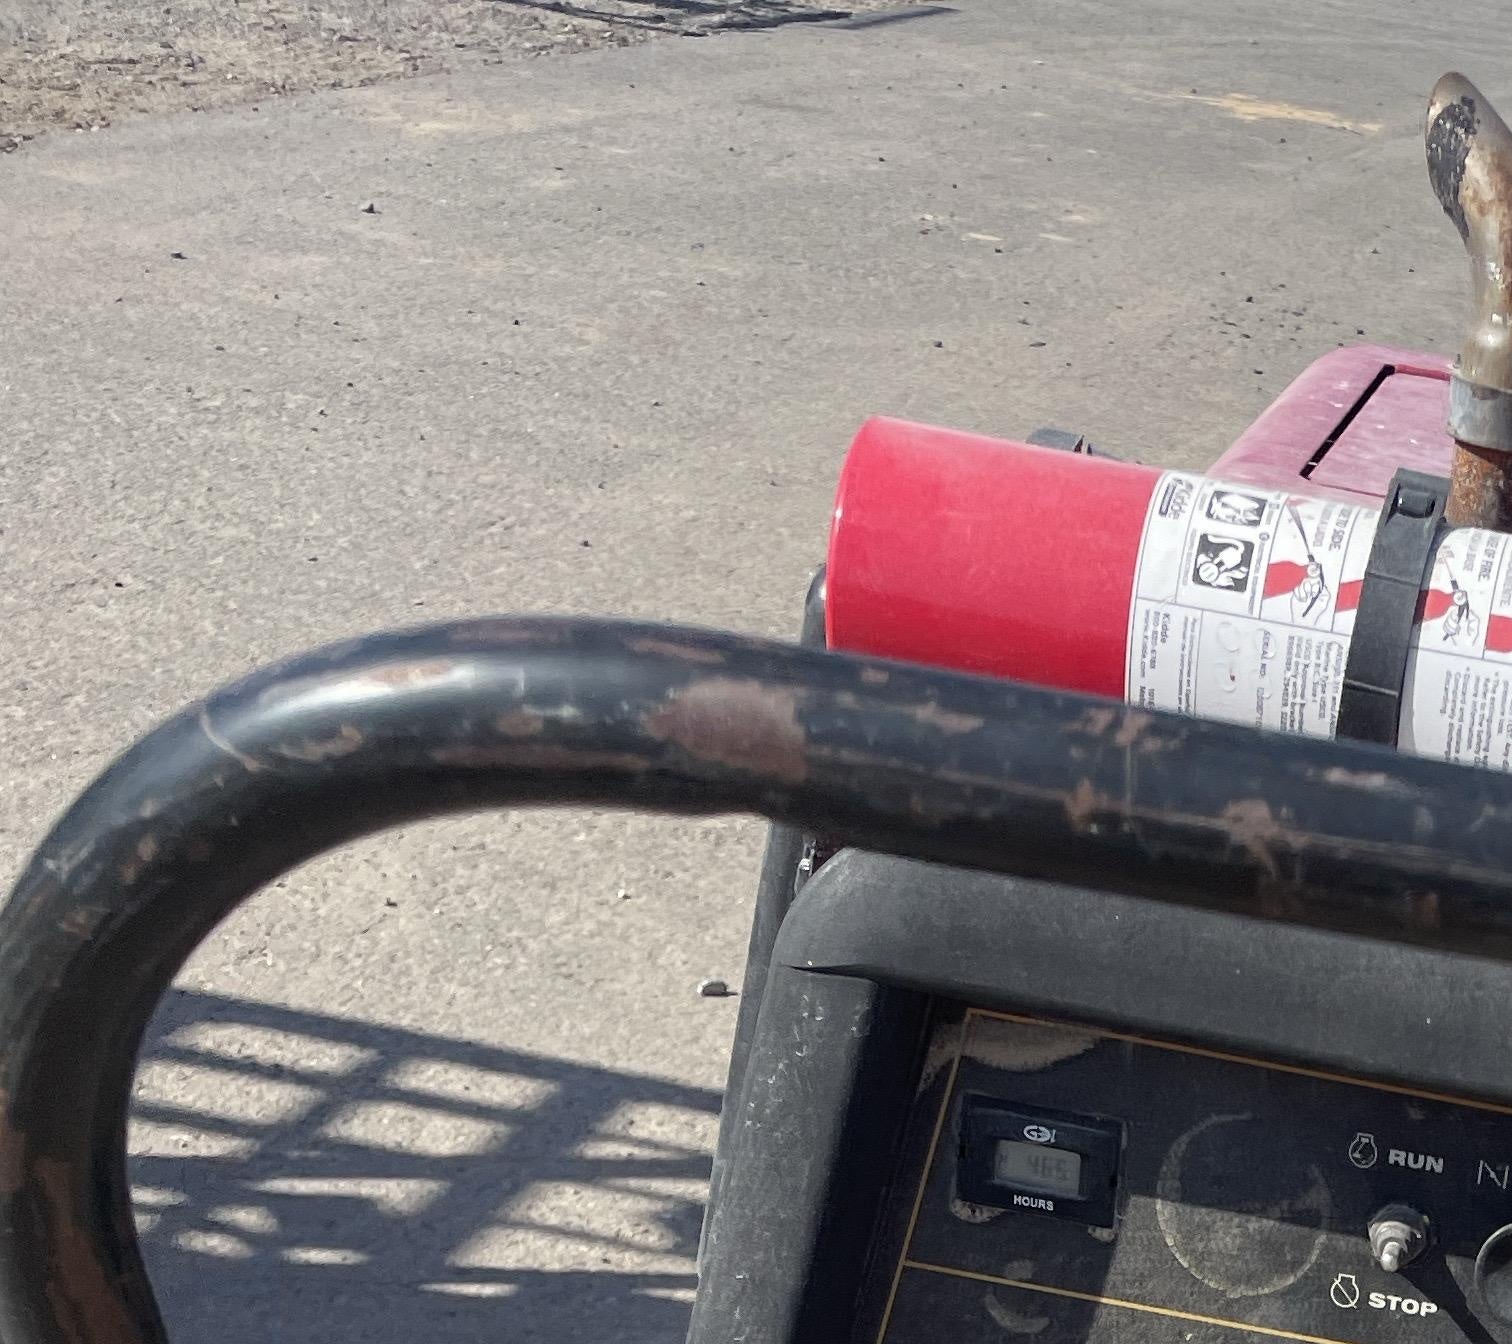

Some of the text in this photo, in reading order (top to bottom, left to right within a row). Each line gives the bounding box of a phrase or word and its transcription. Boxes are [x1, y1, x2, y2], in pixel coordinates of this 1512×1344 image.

[1388, 1148, 1444, 1175] RUN
[1013, 1194, 1054, 1211] HOURS
[1368, 1292, 1438, 1318] STOP
